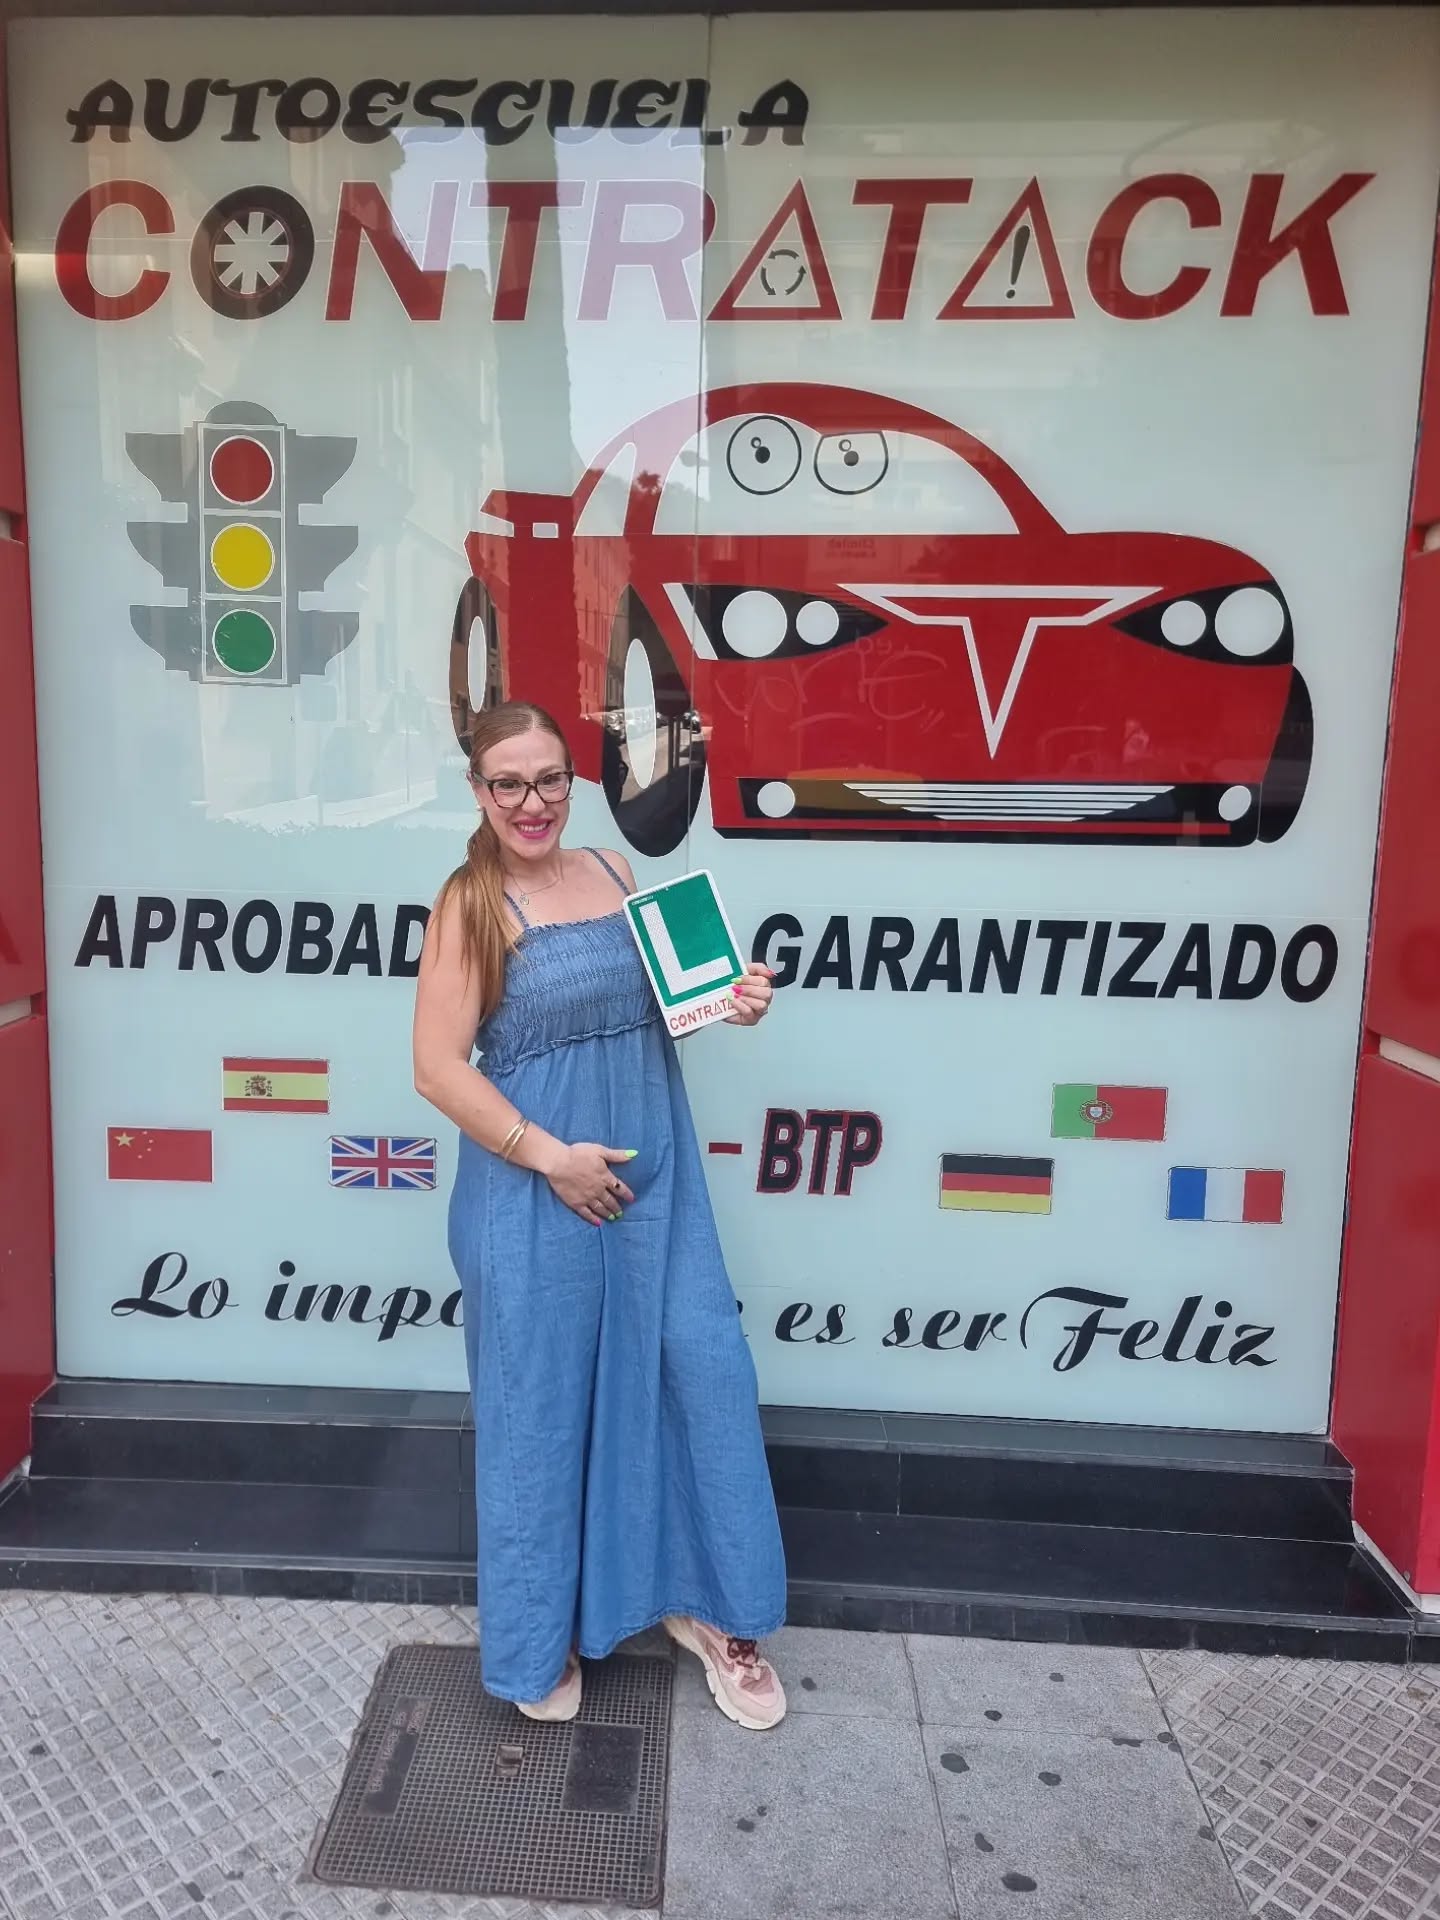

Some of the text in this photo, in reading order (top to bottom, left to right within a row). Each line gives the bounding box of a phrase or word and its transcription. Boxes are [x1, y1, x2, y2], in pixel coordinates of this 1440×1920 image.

[66, 77, 810, 146] AUTOESCUELA
[54, 171, 1377, 323] CONTRATACK
[638, 900, 734, 997] L
[752, 912, 1339, 1004] GARANTIZADO
[756, 1107, 883, 1196] BTP
[111, 1250, 239, 1319] Lo
[774, 1301, 856, 1344] es
[882, 1306, 1008, 1351] ser
[1019, 1286, 1277, 1373] Feliz
